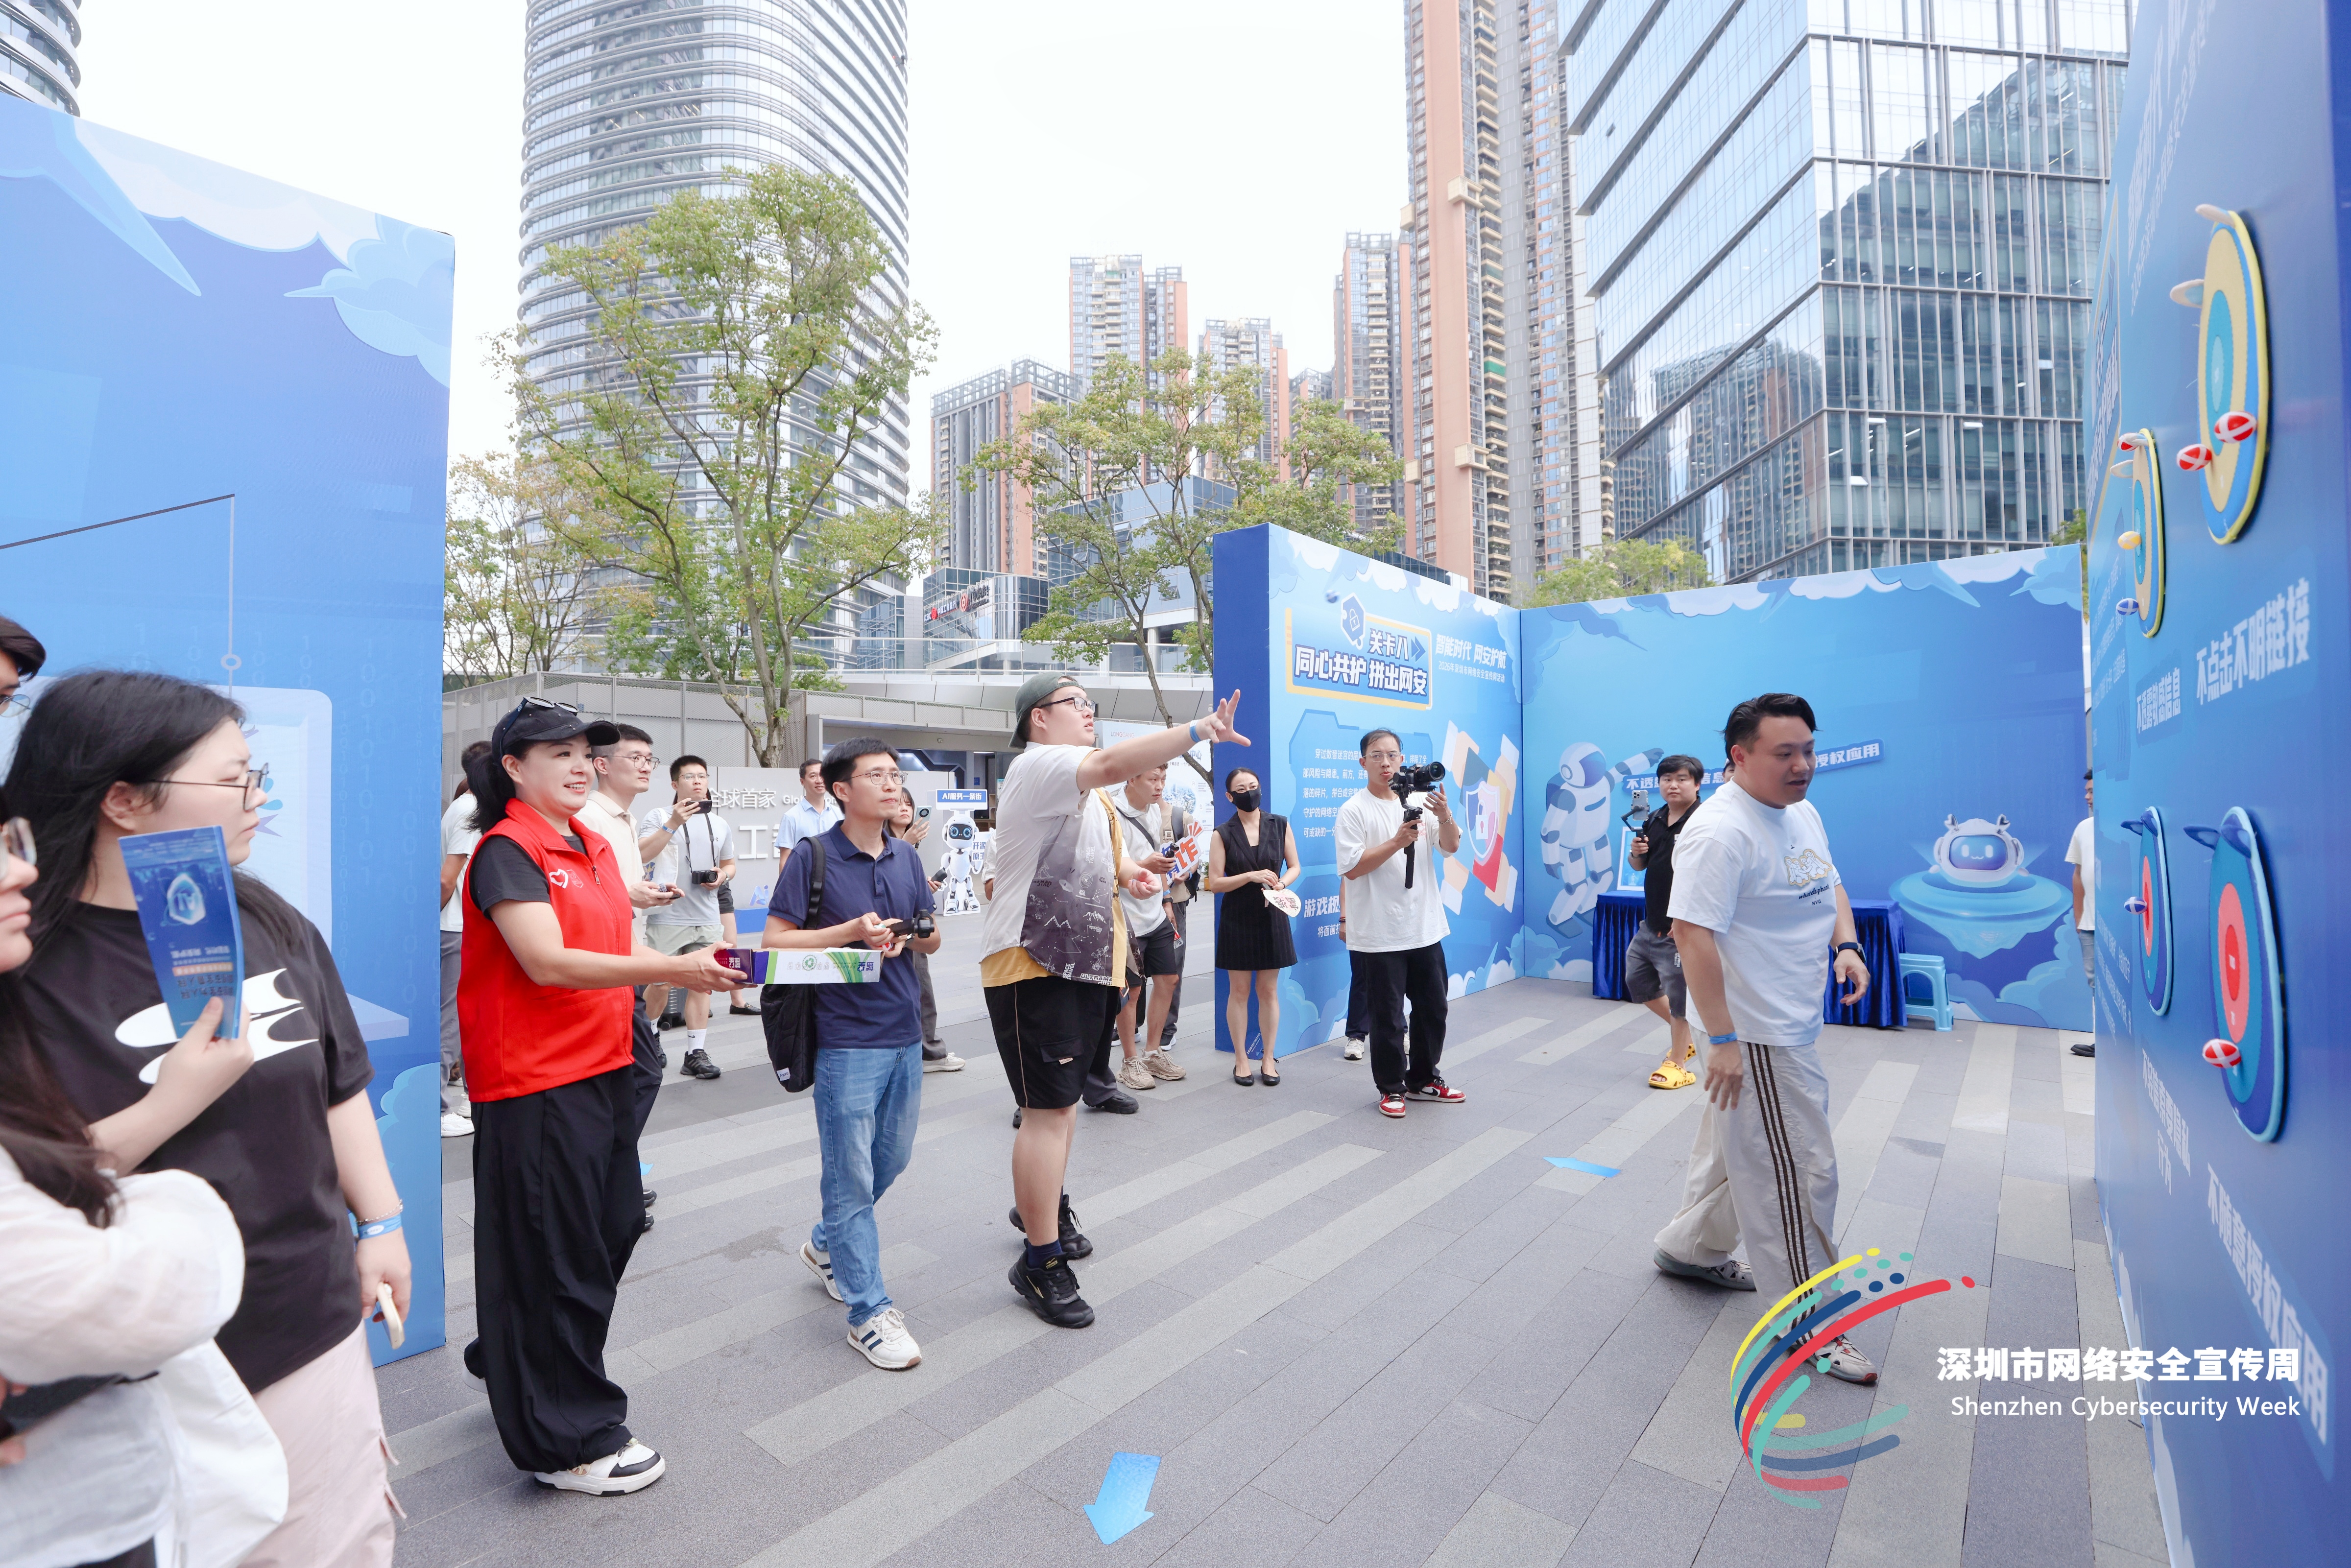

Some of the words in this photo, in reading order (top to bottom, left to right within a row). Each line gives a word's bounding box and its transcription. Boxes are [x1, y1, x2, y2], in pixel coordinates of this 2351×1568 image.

[1368, 628, 1409, 661] 关卡八
[1435, 633, 1472, 661] 智能时代
[1473, 643, 1508, 669] 网安护航
[2196, 578, 2310, 706] 不点击不明链接
[1295, 644, 1367, 686] 同心共护
[1367, 658, 1428, 696] 拼出网安
[1438, 661, 1505, 683] 2026年深圳市网络安全宣传周活动
[2136, 667, 2181, 734] 不透露敏感信息
[1062, 963, 1071, 979] SPACE
[1067, 962, 1076, 980] TRAVEL
[2158, 1129, 2172, 1195] 行为
[2207, 1162, 2328, 1446] 不随意授权应用
